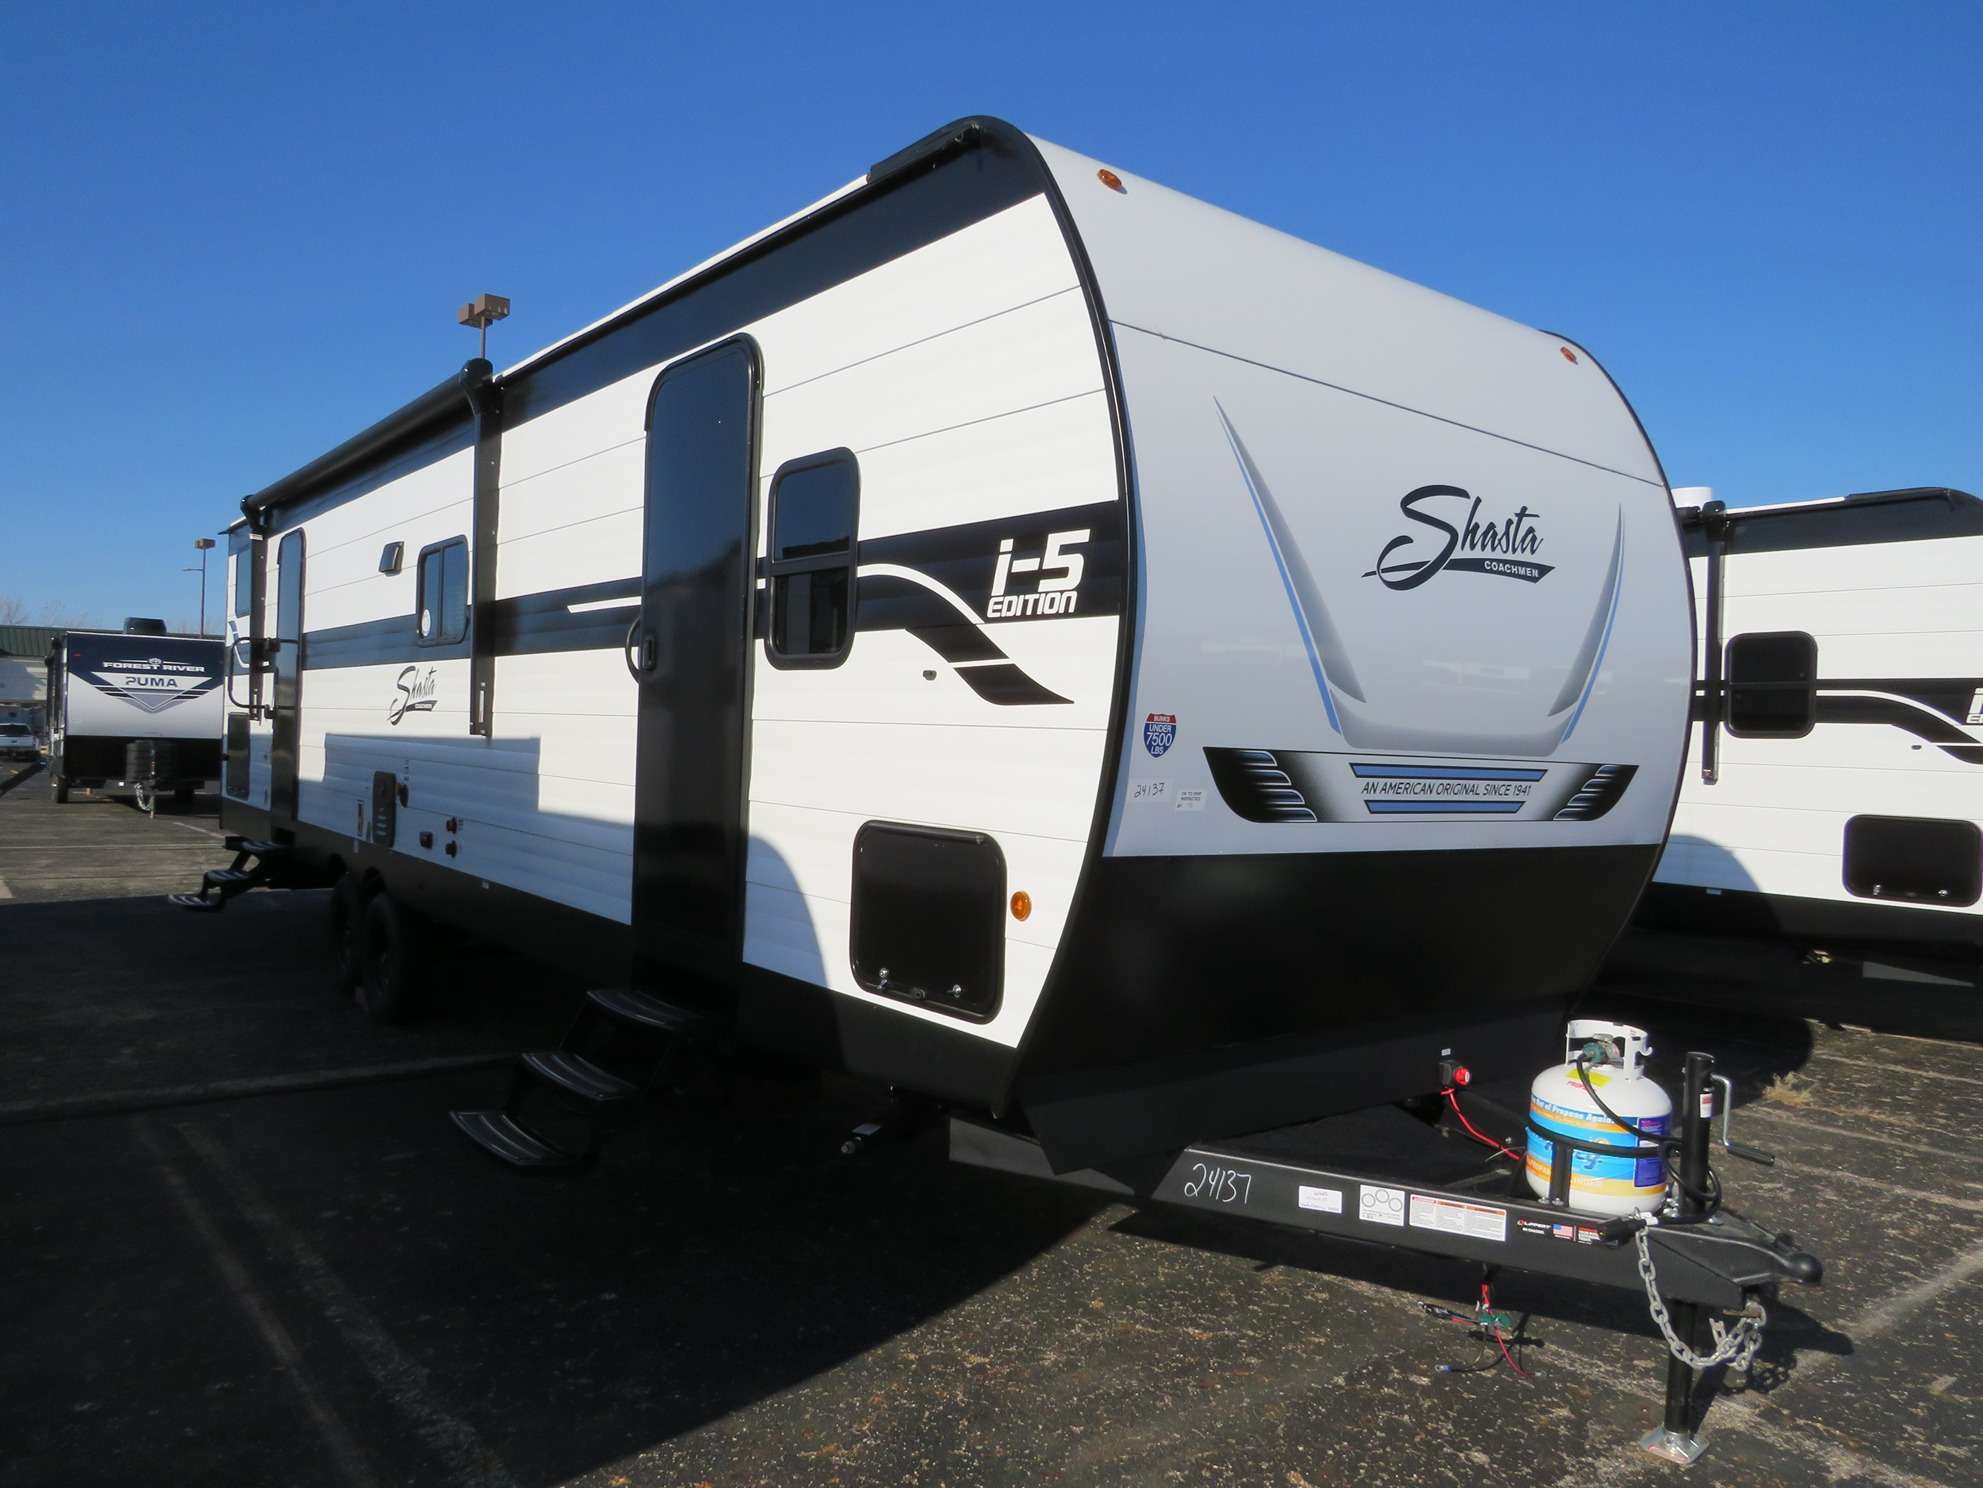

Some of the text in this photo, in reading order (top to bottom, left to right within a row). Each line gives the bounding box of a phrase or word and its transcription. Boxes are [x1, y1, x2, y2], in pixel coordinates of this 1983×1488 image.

[1376, 484, 1543, 591] Shasta
[991, 528, 1091, 597] i-5
[1484, 560, 1539, 578] COACHMEN
[986, 591, 1078, 618] EDITION
[103, 661, 205, 672] FOREST RIVER
[125, 676, 178, 688] PUMA
[386, 665, 437, 726] Shasta
[1149, 724, 1172, 733] UNDER
[1146, 732, 1172, 746] 7500
[1151, 746, 1164, 754] LBS
[1361, 782, 1532, 797] AN AMERICAN ORIGINAL SINCE 1941
[1184, 1163, 1252, 1205] 24137
